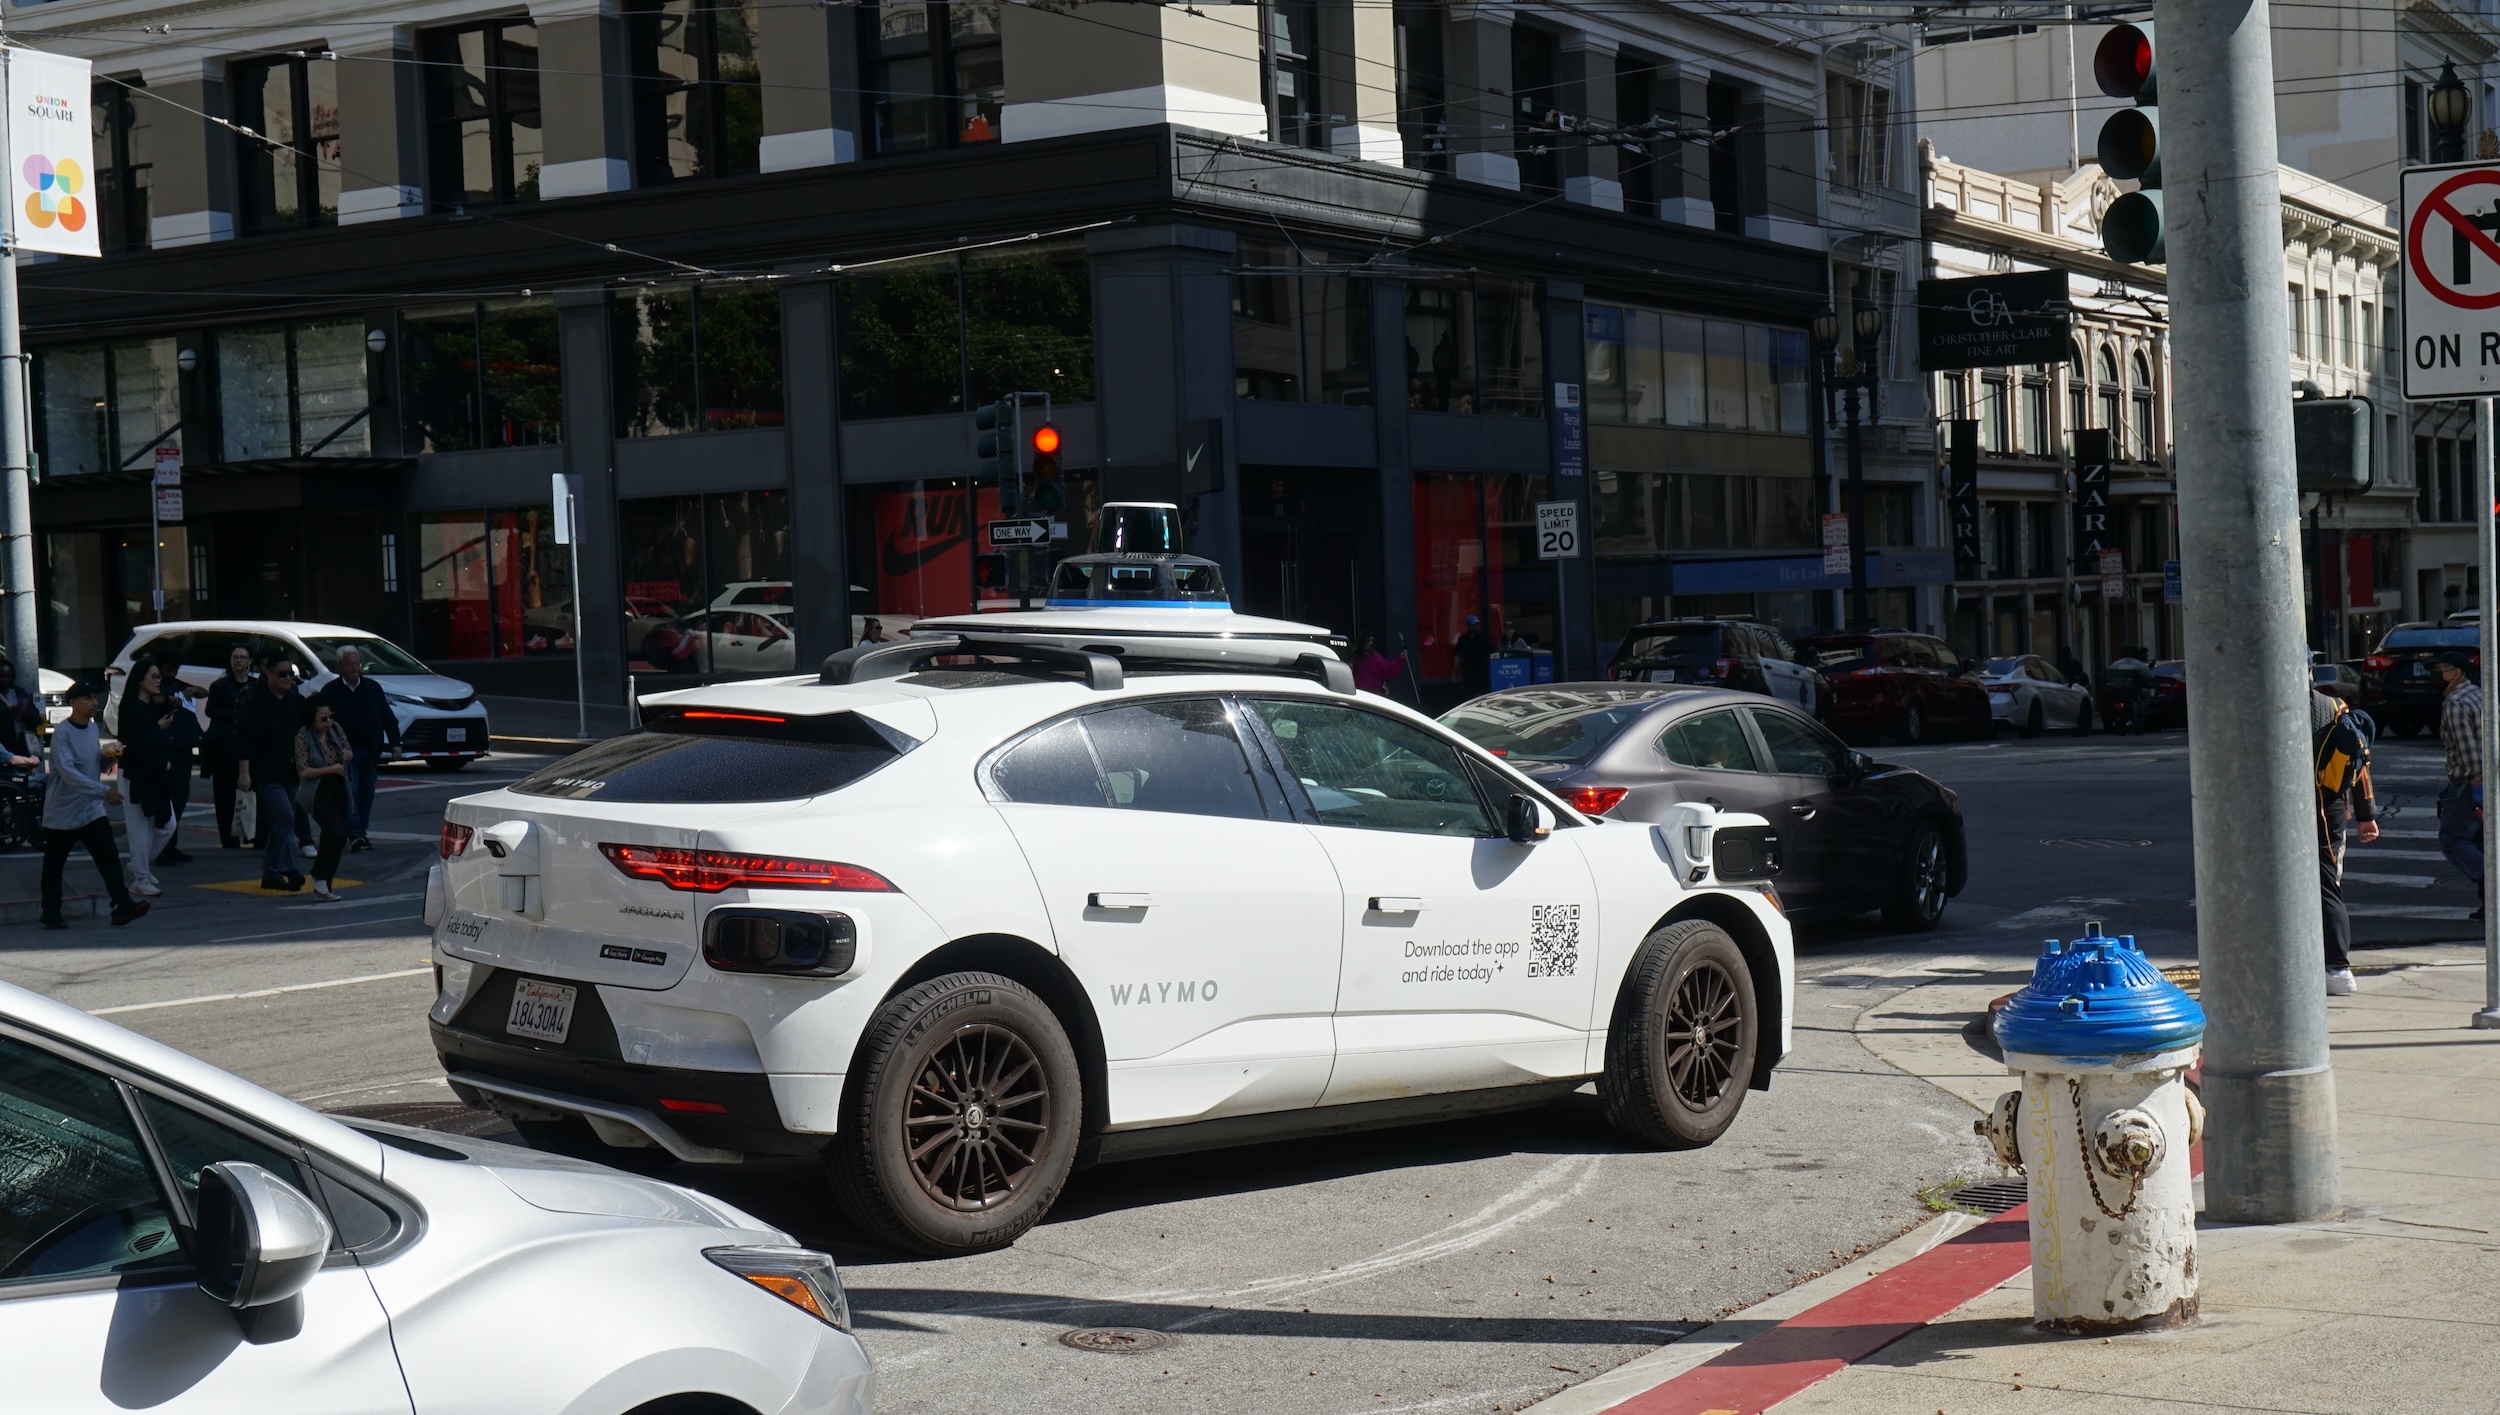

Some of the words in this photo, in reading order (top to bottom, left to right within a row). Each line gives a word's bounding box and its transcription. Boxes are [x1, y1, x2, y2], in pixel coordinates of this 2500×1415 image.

[36, 95, 67, 107] UNION
[28, 104, 76, 122] SQUARE
[1967, 346, 1992, 358] FINE
[1995, 344, 2018, 356] ART
[2415, 333, 2461, 370] ON
[1563, 412, 1580, 426] Retail
[1572, 426, 1580, 438] for
[1564, 437, 1581, 449] Lease
[901, 495, 969, 538] RUN
[1540, 507, 1574, 518] SPEED
[2082, 464, 2108, 556] ZARA
[1544, 519, 1570, 529] LIMIT
[1955, 482, 1975, 557] ZARA
[995, 528, 1011, 538] ONE
[1015, 526, 1031, 536] WAY
[1543, 531, 1574, 552] 20
[1779, 565, 1829, 581] Retai
[1619, 670, 1632, 678] 284
[552, 778, 606, 789] WAYMO
[619, 905, 684, 920] JAGUAR
[446, 916, 460, 934] Ride
[460, 920, 483, 942] today
[1404, 939, 1469, 958] Download
[1472, 939, 1492, 955] the
[1495, 942, 1520, 958] app
[1402, 965, 1428, 983] and
[1430, 965, 1455, 982] ride
[1457, 963, 1494, 984] today
[526, 984, 563, 1001] California
[1110, 980, 1218, 1006] WAYMO
[511, 1000, 565, 1034] 18430A4
[921, 990, 990, 1030] MICHELIN
